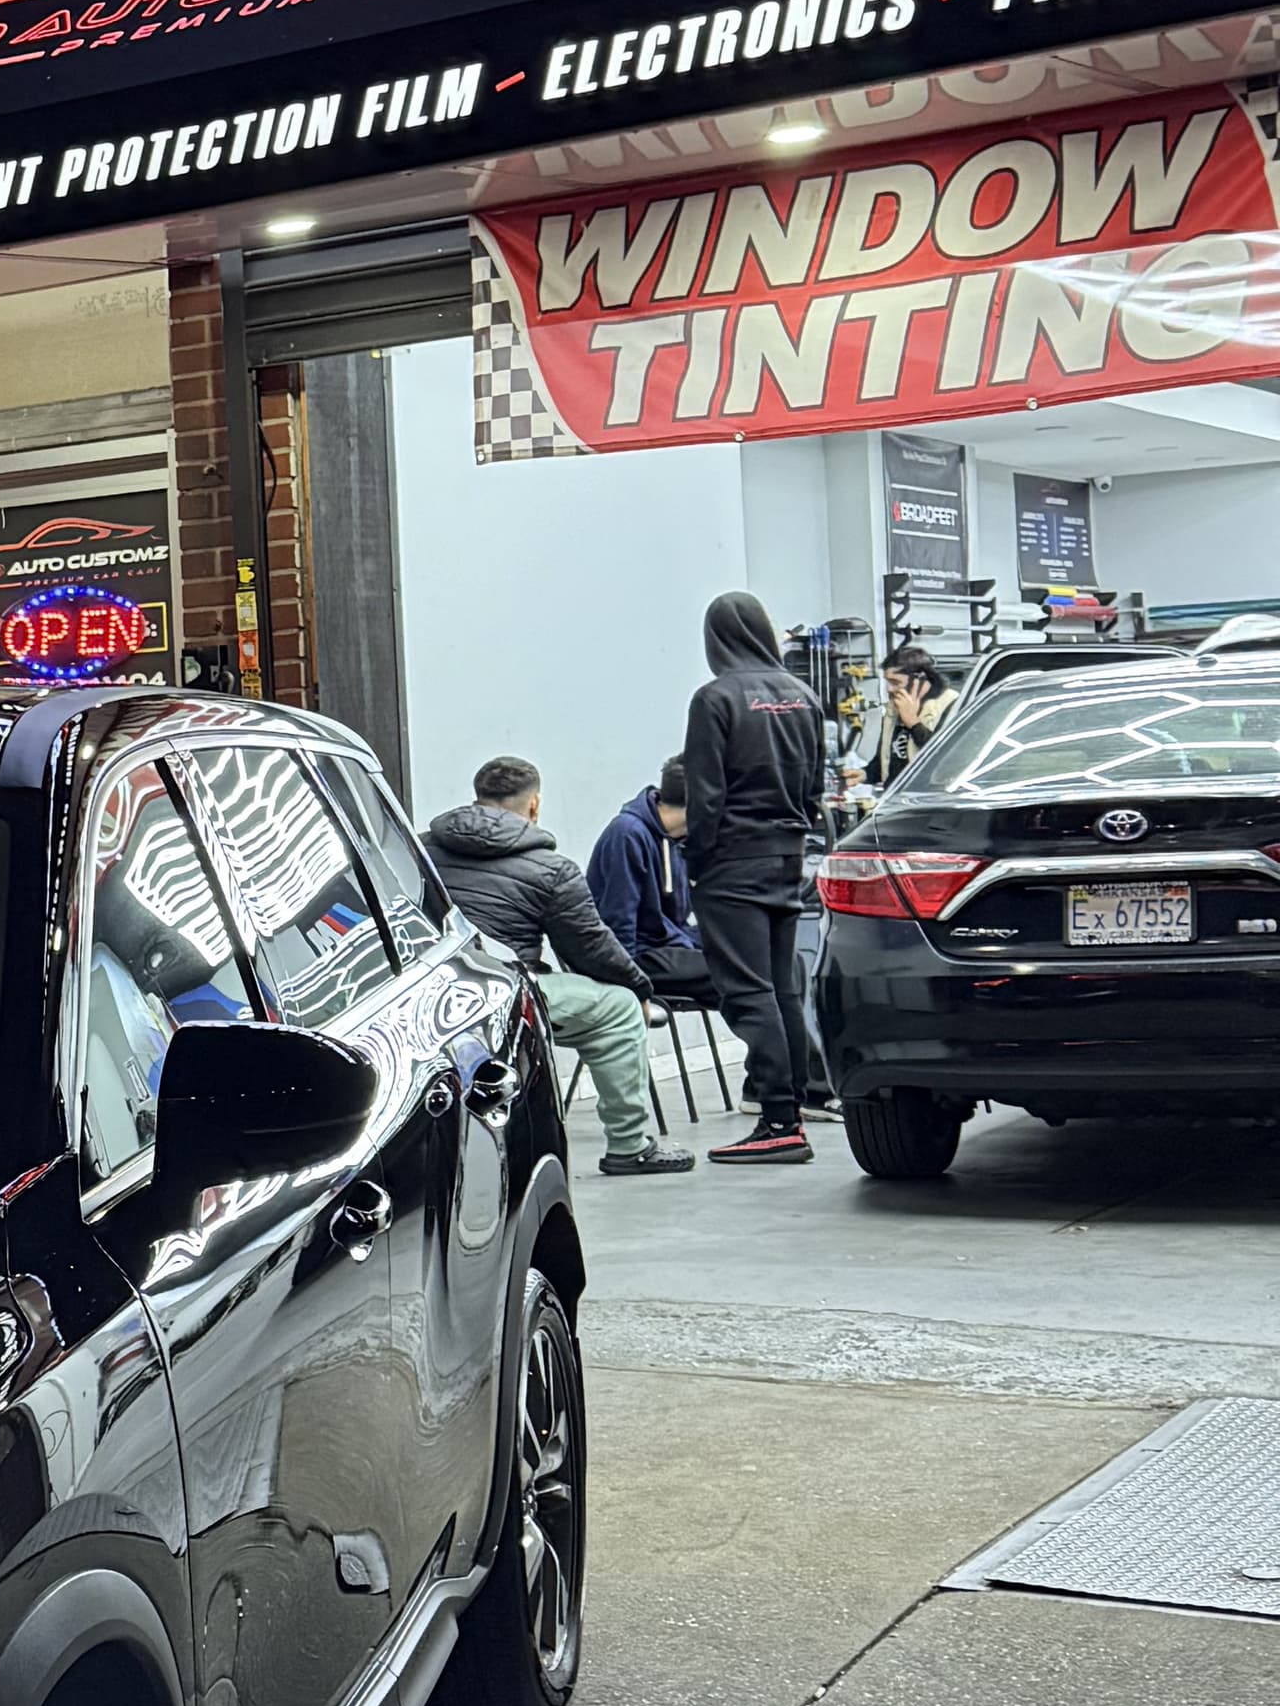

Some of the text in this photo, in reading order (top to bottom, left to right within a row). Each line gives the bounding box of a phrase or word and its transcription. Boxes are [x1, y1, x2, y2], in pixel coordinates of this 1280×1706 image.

[55, 93, 343, 200] PROTECTION
[356, 63, 485, 139] FILM
[535, 105, 1231, 316] WINDOW
[590, 231, 1255, 429] TINTING
[7, 558, 64, 576] AUTO
[67, 545, 169, 570] CUSTOMZ
[4, 606, 139, 657] OPEN
[1115, 897, 1190, 928] 67552
